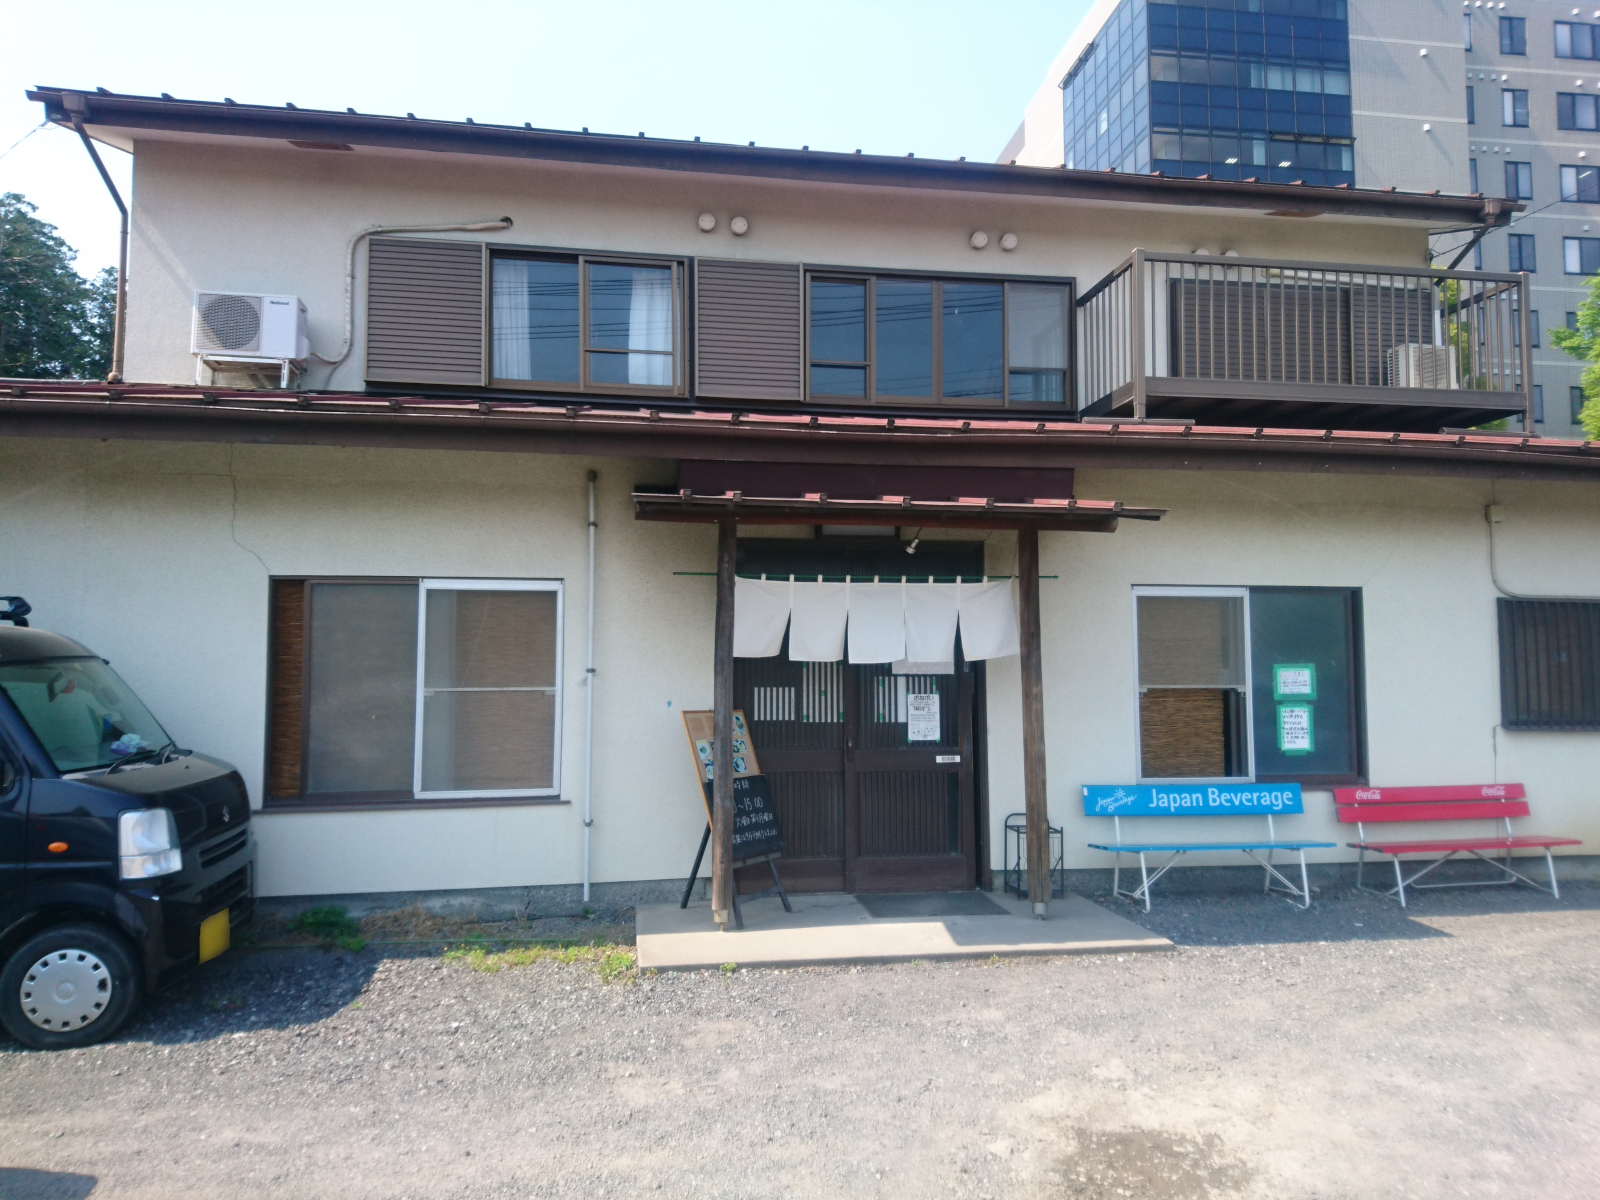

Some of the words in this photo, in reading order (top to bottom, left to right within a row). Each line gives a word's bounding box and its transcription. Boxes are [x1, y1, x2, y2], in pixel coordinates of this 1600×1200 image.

[1356, 789, 1381, 800] Coca-Cola
[1482, 786, 1505, 796] Coca-Cola
[1149, 788, 1203, 812] Japan
[1208, 787, 1293, 810] Beverage
